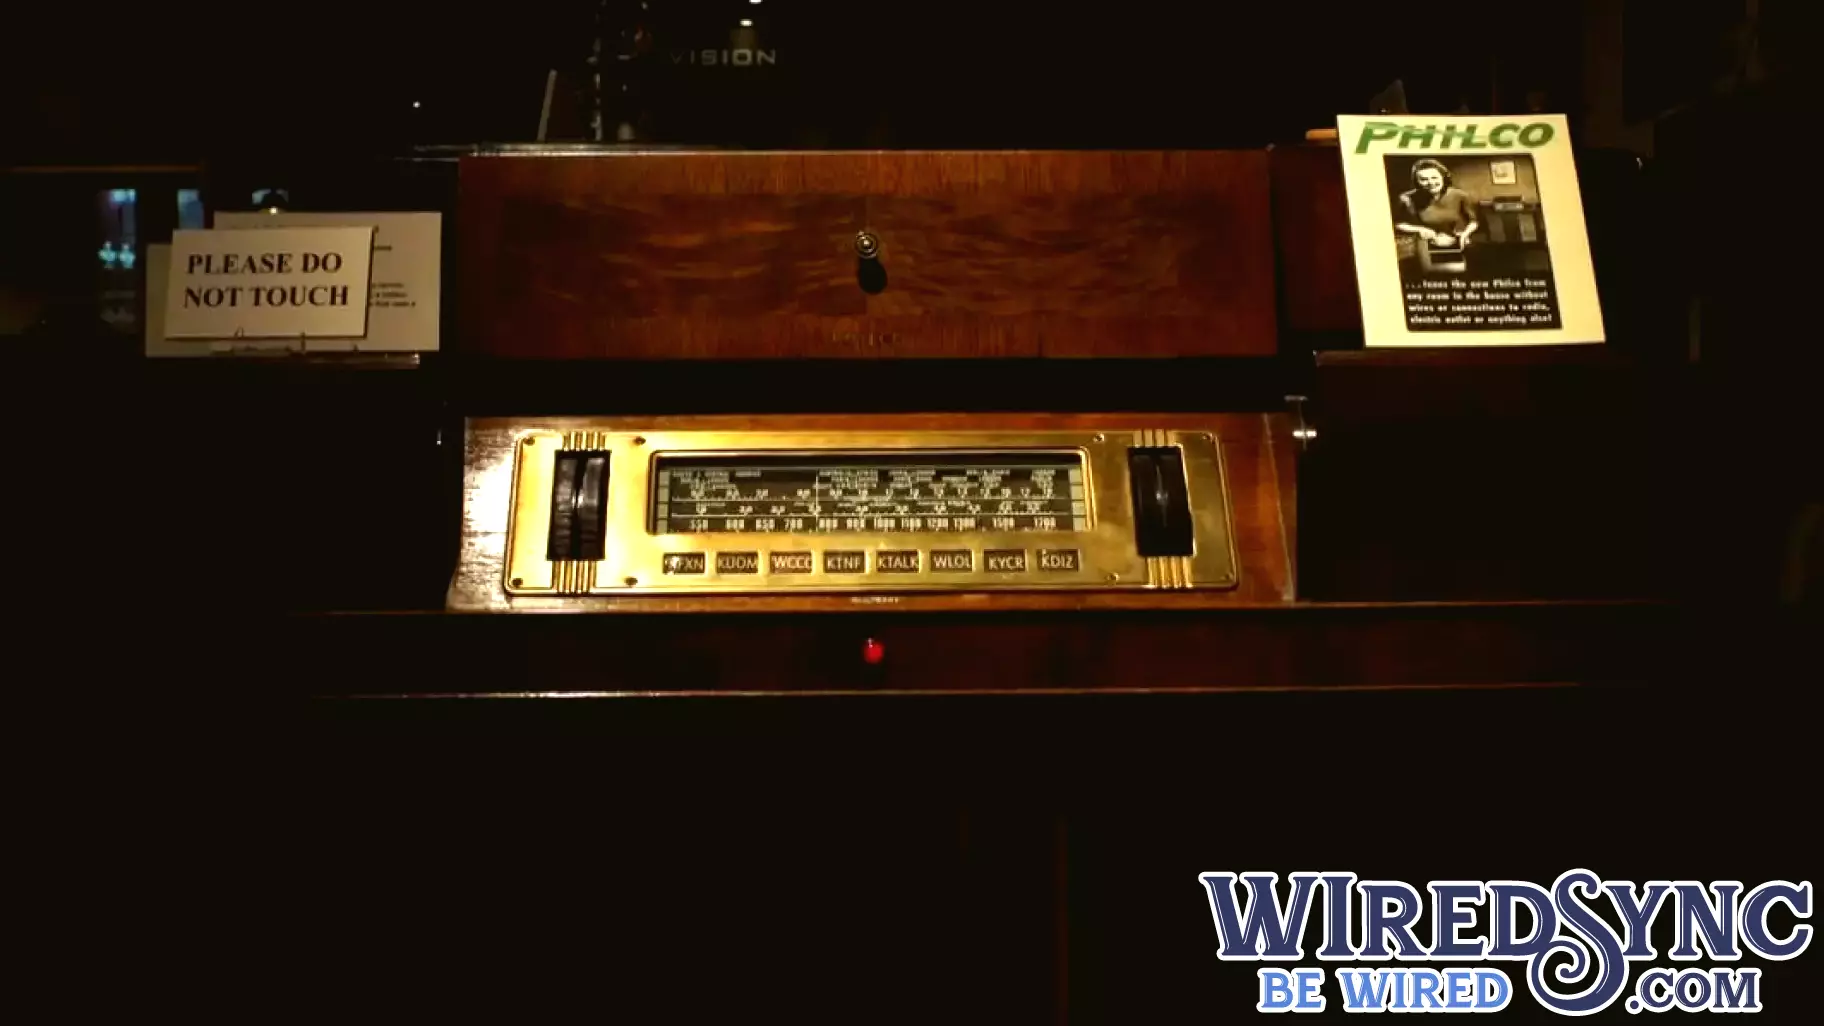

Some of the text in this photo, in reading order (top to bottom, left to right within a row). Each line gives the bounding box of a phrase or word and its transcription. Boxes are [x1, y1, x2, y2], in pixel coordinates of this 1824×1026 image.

[670, 49, 776, 66] VISION
[1354, 121, 1556, 154] PHILCO
[187, 252, 342, 275] PLEASE DO
[1493, 278, 1521, 288] Philco
[1524, 278, 1546, 287] from
[183, 286, 244, 308] NOT
[248, 285, 349, 307] TOUCH
[1466, 291, 1480, 300] the
[1484, 291, 1510, 300] house
[1513, 290, 1548, 299] without
